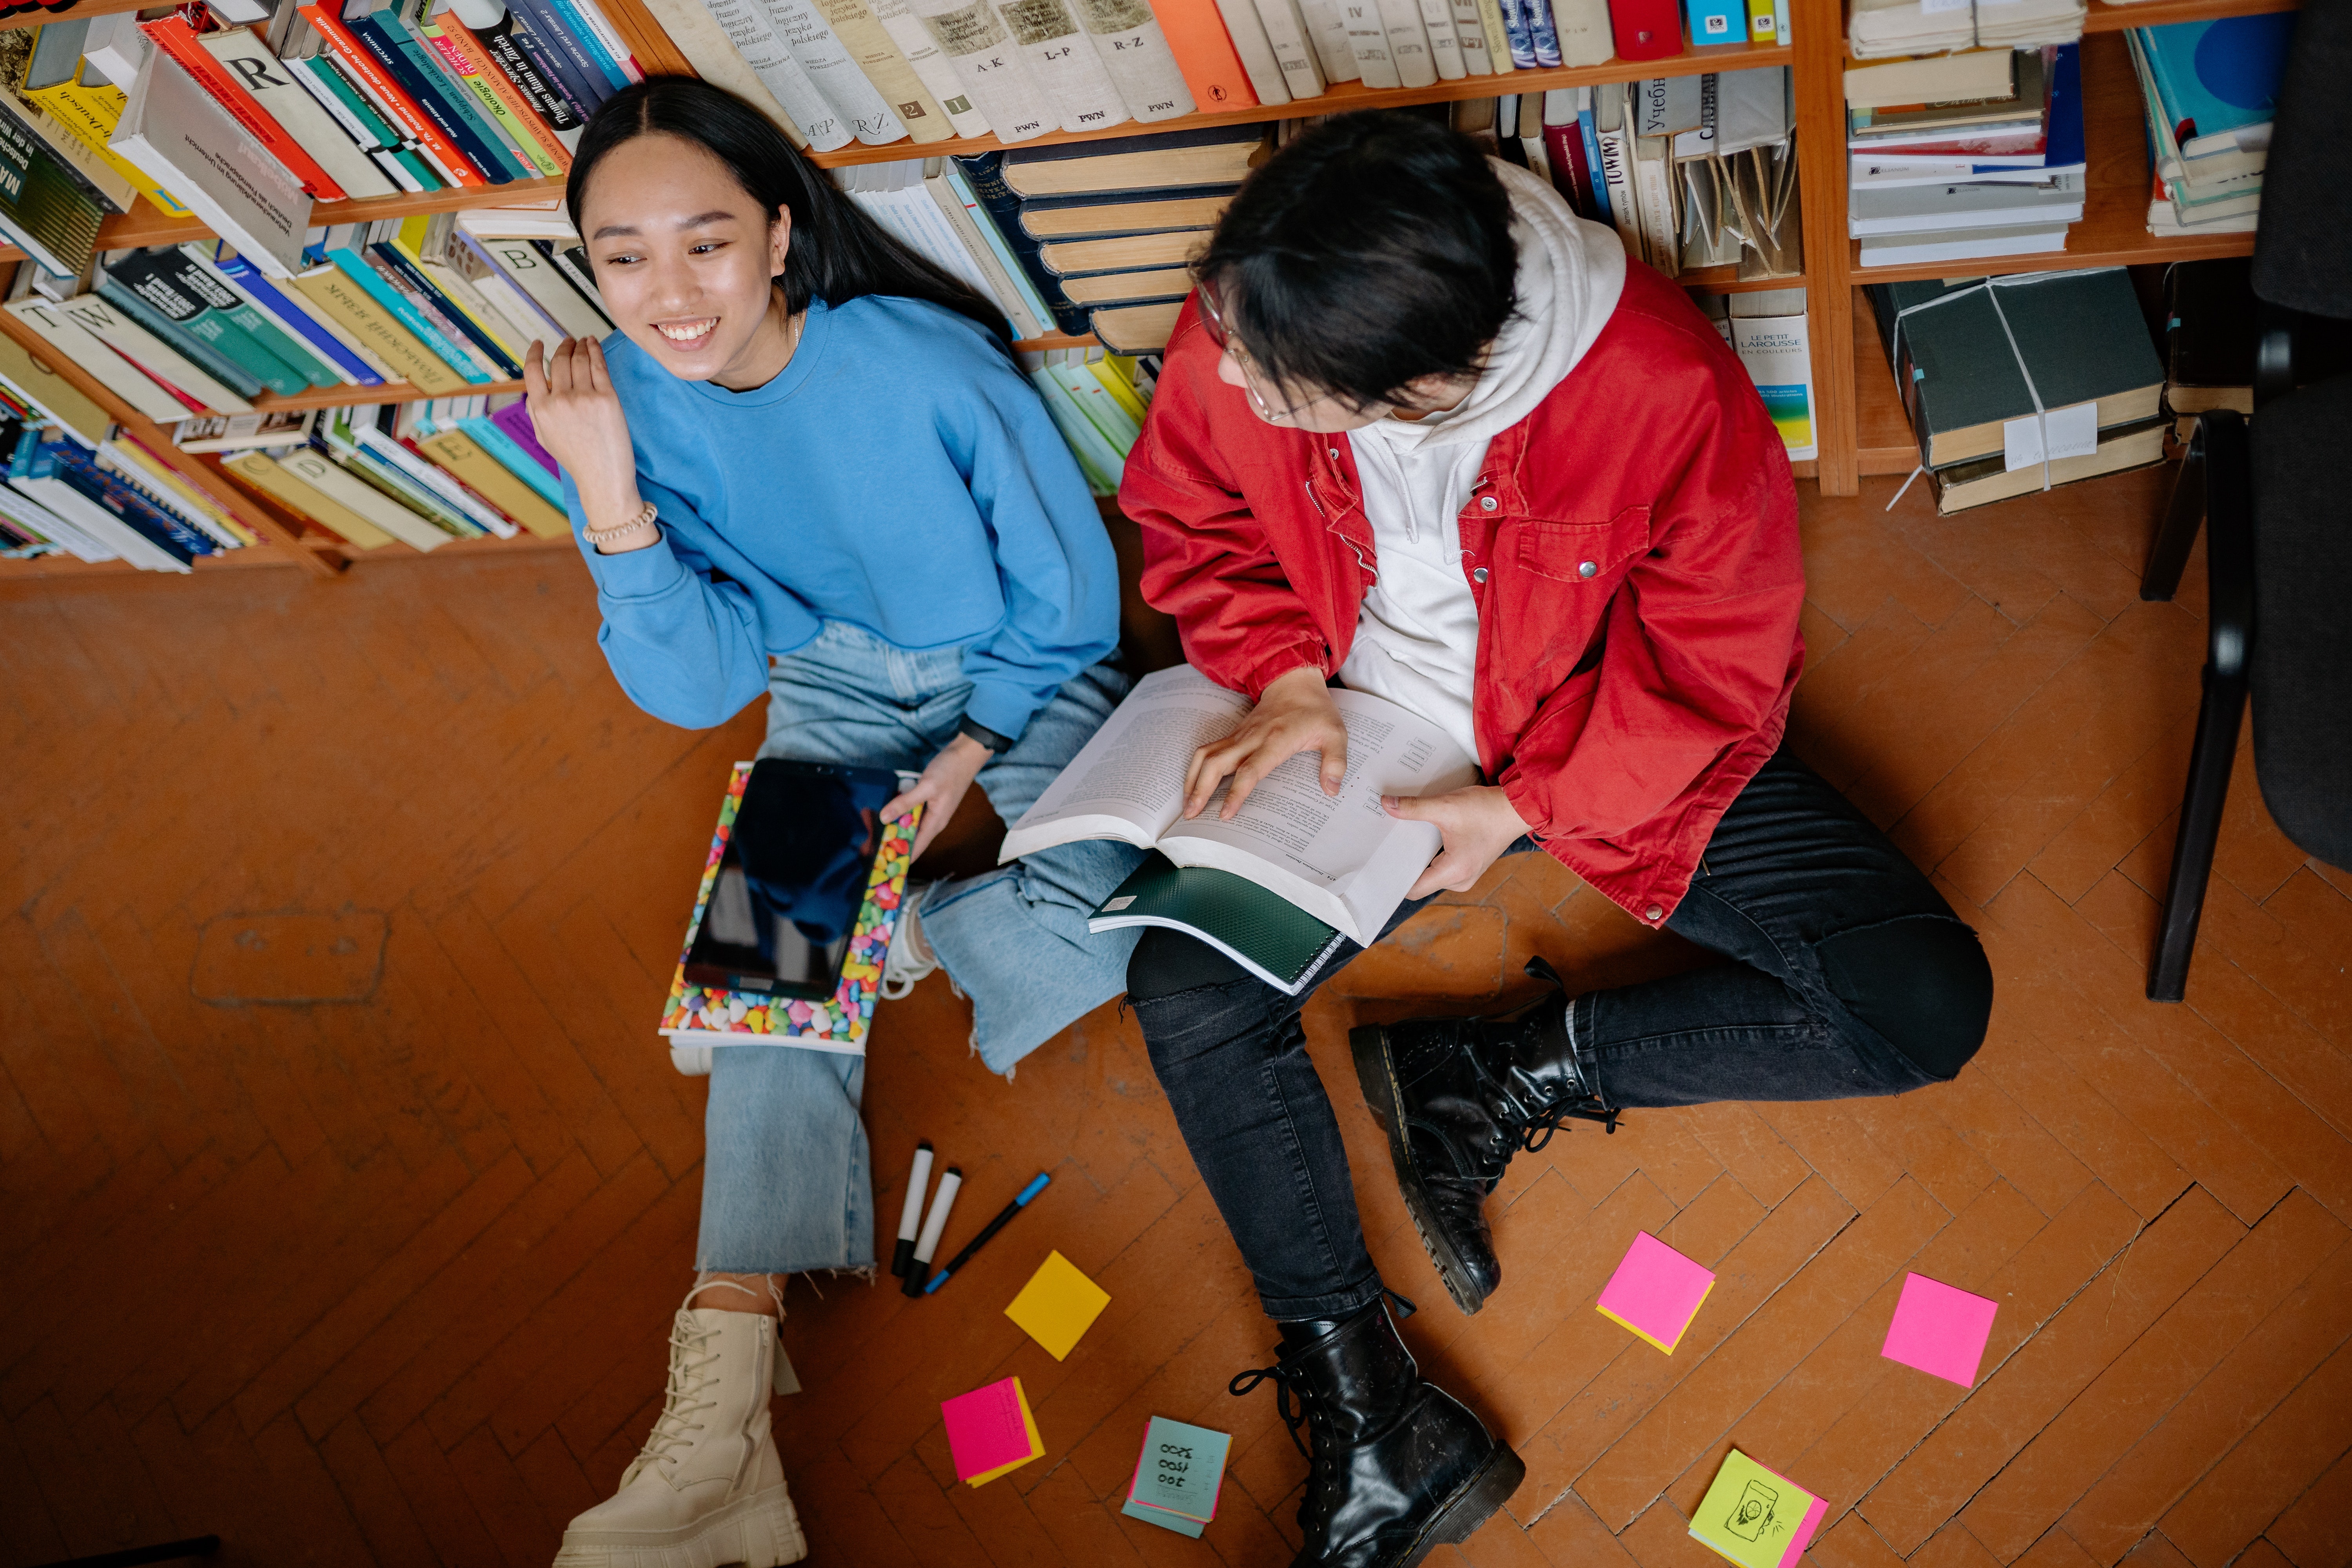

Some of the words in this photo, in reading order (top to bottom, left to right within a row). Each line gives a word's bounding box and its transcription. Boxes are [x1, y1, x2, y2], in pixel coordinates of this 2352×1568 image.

[540, 8, 548, 16] 2
[715, 6, 740, 20] frazeo
[768, 3, 793, 16] frazeo
[829, 1, 858, 16] języka
[830, 8, 868, 27] polskiego
[1348, 6, 1363, 18] IV
[516, 13, 537, 38] Literatur
[544, 13, 564, 36] Literatur
[575, 0, 589, 16] MANICA
[588, 16, 615, 51] WRATISLAVIENSIA
[720, 13, 753, 30] logiczny
[775, 10, 809, 27] logiczny
[314, 14, 354, 55] Grammatik
[446, 23, 456, 34] 52
[564, 0, 617, 69] Standardformulierungen
[791, 29, 830, 47] polskiego
[361, 31, 394, 66] SPECIMINA
[414, 35, 433, 55] Deutsch
[454, 32, 475, 55] BAND
[491, 32, 521, 65] Zürich
[534, 36, 546, 49] und
[562, 35, 572, 47] und
[563, 9, 586, 36] deutsche
[582, 34, 612, 71] Vertragstexte
[735, 31, 773, 49] polskiego
[433, 38, 469, 78] SCHÜLER
[448, 43, 476, 74] DUDEN
[543, 45, 563, 69] Sprache
[569, 44, 590, 69] Sprache
[749, 55, 771, 66] WIEDZA
[805, 56, 826, 65] WIEDZA
[862, 53, 895, 66] POWSZECHNA
[864, 50, 885, 60] WIEDZA
[910, 46, 932, 56] WIEDZA
[350, 52, 382, 86] deutsche
[410, 47, 448, 90] Lexikologie
[486, 45, 521, 84] Sprecher
[514, 60, 528, 75] in
[530, 50, 555, 79] Faschismus
[753, 55, 791, 71] POWSZECHNA
[809, 56, 847, 72] POWSZECHNA
[225, 57, 290, 91] R
[447, 73, 467, 94] Schreiner
[473, 56, 509, 95] ALMANACH
[522, 69, 545, 95] Mann
[551, 75, 559, 83] im
[378, 83, 398, 104] Neue
[472, 78, 506, 118] Ökologie
[515, 80, 546, 115] Thomas
[555, 80, 574, 101] Sprache
[421, 98, 440, 119] Atlantis
[448, 89, 477, 123] Schippan
[539, 91, 570, 126] Thomas
[905, 103, 919, 117] 2
[951, 98, 965, 113] 1
[1148, 99, 1175, 114] PWN
[1646, 77, 1666, 131] Учебн
[397, 104, 425, 132] Rolland
[437, 116, 449, 129] und
[504, 93, 550, 145] SLAWISTISCHER
[1078, 109, 1106, 123] PWN
[1015, 120, 1040, 133] PWN
[10, 131, 27, 148] der
[422, 130, 434, 143] Th.
[23, 143, 36, 156] in
[182, 133, 218, 167] Unterricht
[431, 141, 442, 152] M.
[546, 142, 569, 167] WIENER
[215, 163, 226, 174] im
[1602, 140, 1623, 188] TUWIM
[212, 152, 259, 196] Fremdsprache
[256, 192, 269, 205] als
[265, 201, 294, 229] Deutsch
[1622, 206, 1631, 225] Jarmark
[499, 249, 537, 270] B
[22, 305, 60, 328] T
[67, 305, 116, 332] W
[1741, 339, 1801, 347] LAROUSSE
[297, 459, 326, 479] D
[1282, 785, 1298, 793] Service
[1298, 791, 1319, 803] Customer
[1324, 802, 1336, 811] Type
[1286, 822, 1299, 830] outlets
[1299, 828, 1315, 838] Discount
[1283, 842, 1303, 853] competition
[1285, 853, 1302, 864] Decisions
[1302, 862, 1323, 875] Distribution
